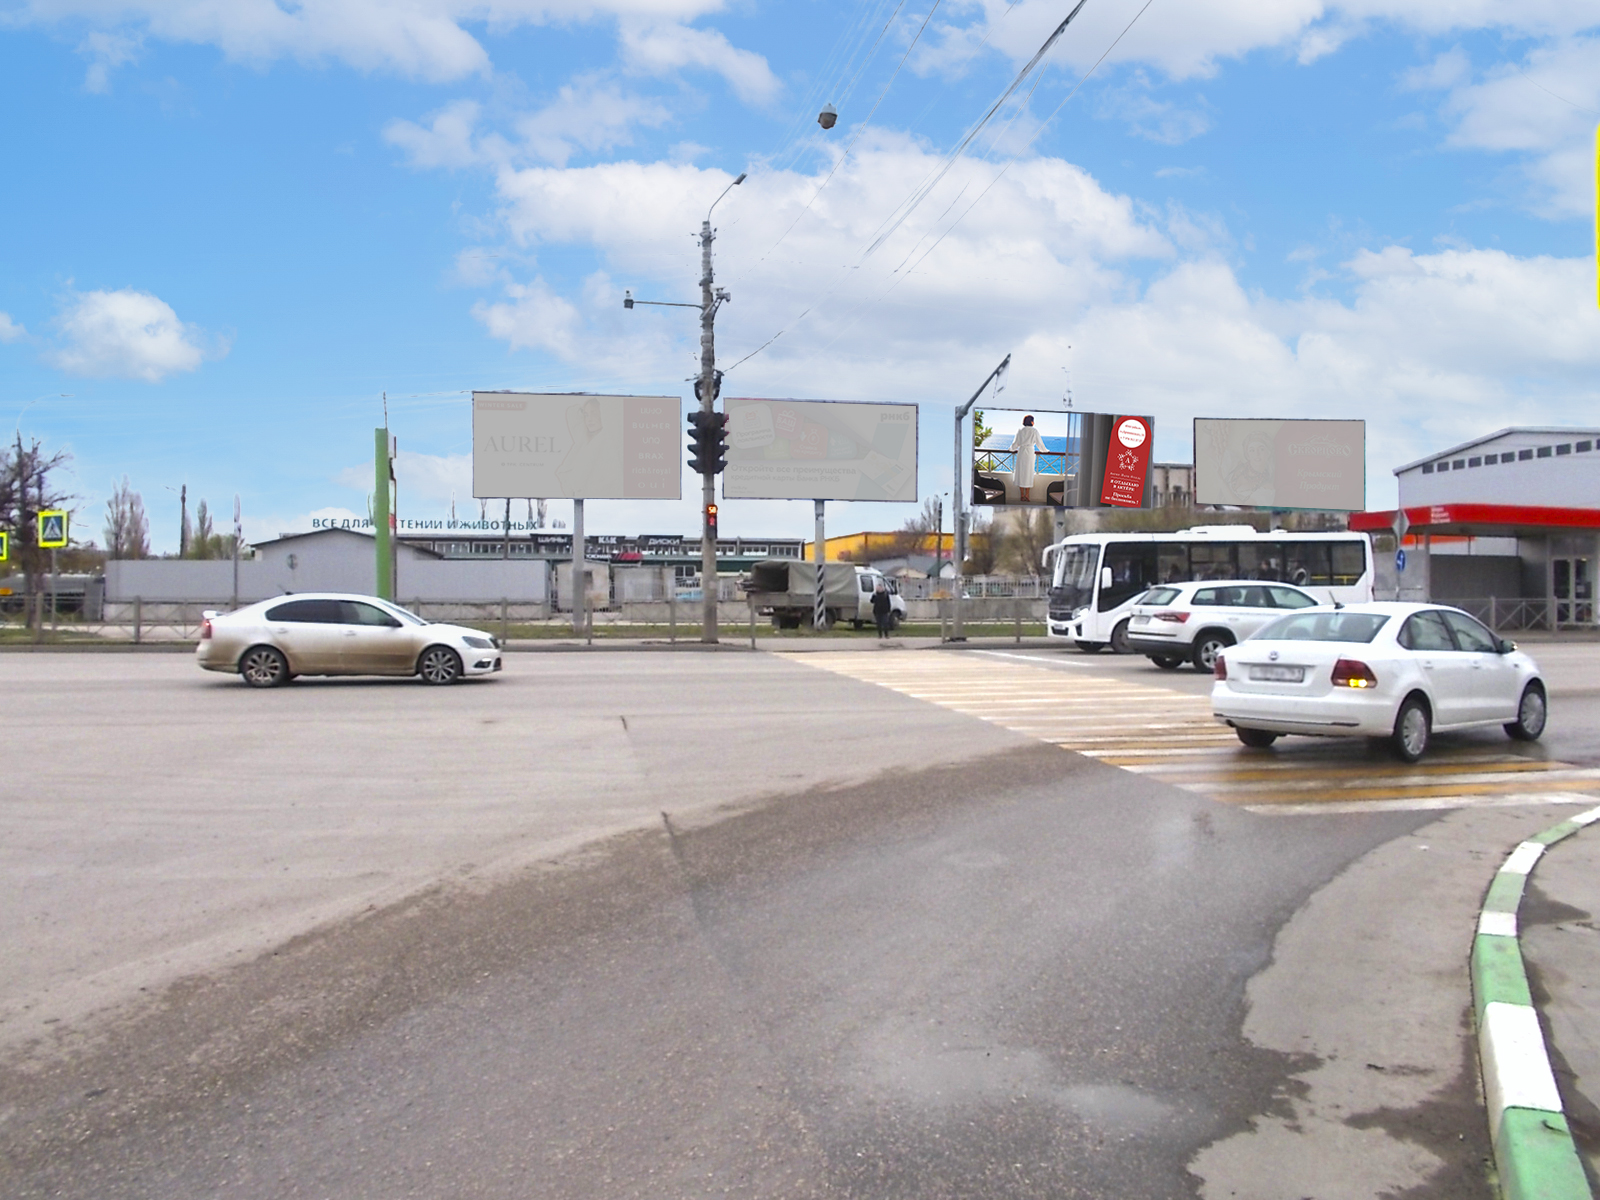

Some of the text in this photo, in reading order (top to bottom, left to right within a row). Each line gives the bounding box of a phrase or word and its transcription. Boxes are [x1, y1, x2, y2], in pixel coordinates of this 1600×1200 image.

[632, 422, 671, 430] BULMER
[483, 435, 562, 454] AUREL
[638, 452, 664, 460] BRAX
[730, 464, 774, 473] Откройте
[793, 467, 857, 475] преимущества
[1296, 469, 1342, 479] Крымский
[1299, 481, 1340, 492] Продукт
[312, 518, 338, 528] ВСЕ
[341, 518, 369, 530] ДЛЯ
[459, 519, 538, 530] ЖИВОТНЫХ
[648, 538, 680, 546] ДИСКИ
